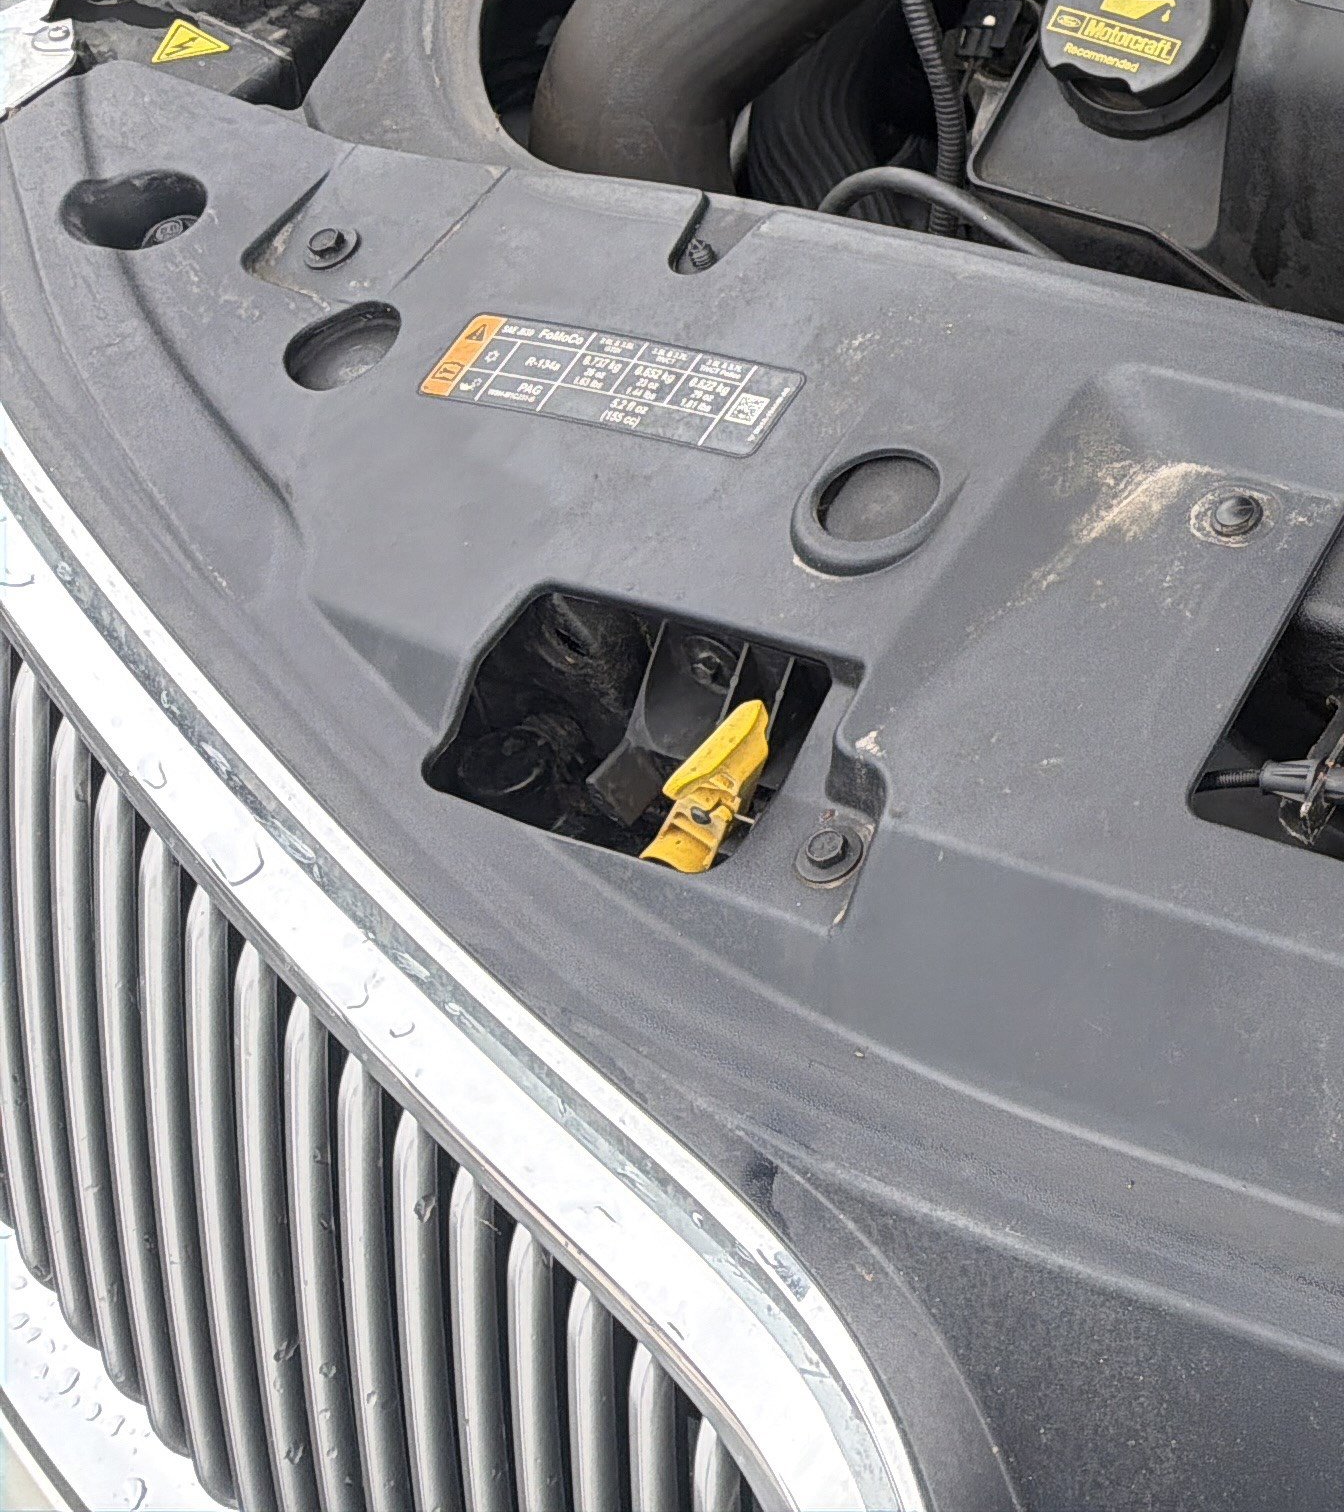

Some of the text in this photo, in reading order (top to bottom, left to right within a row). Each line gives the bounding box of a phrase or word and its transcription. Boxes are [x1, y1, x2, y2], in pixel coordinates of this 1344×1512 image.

[1083, 19, 1172, 62] Motorcraft
[1063, 41, 1140, 74] Recommended
[538, 328, 585, 346] FoMoCo
[524, 356, 562, 371] R-134a
[607, 360, 622, 374] kg
[661, 370, 676, 385] kg
[516, 382, 544, 396] PAG
[715, 383, 731, 397] kg
[634, 405, 649, 415] oz
